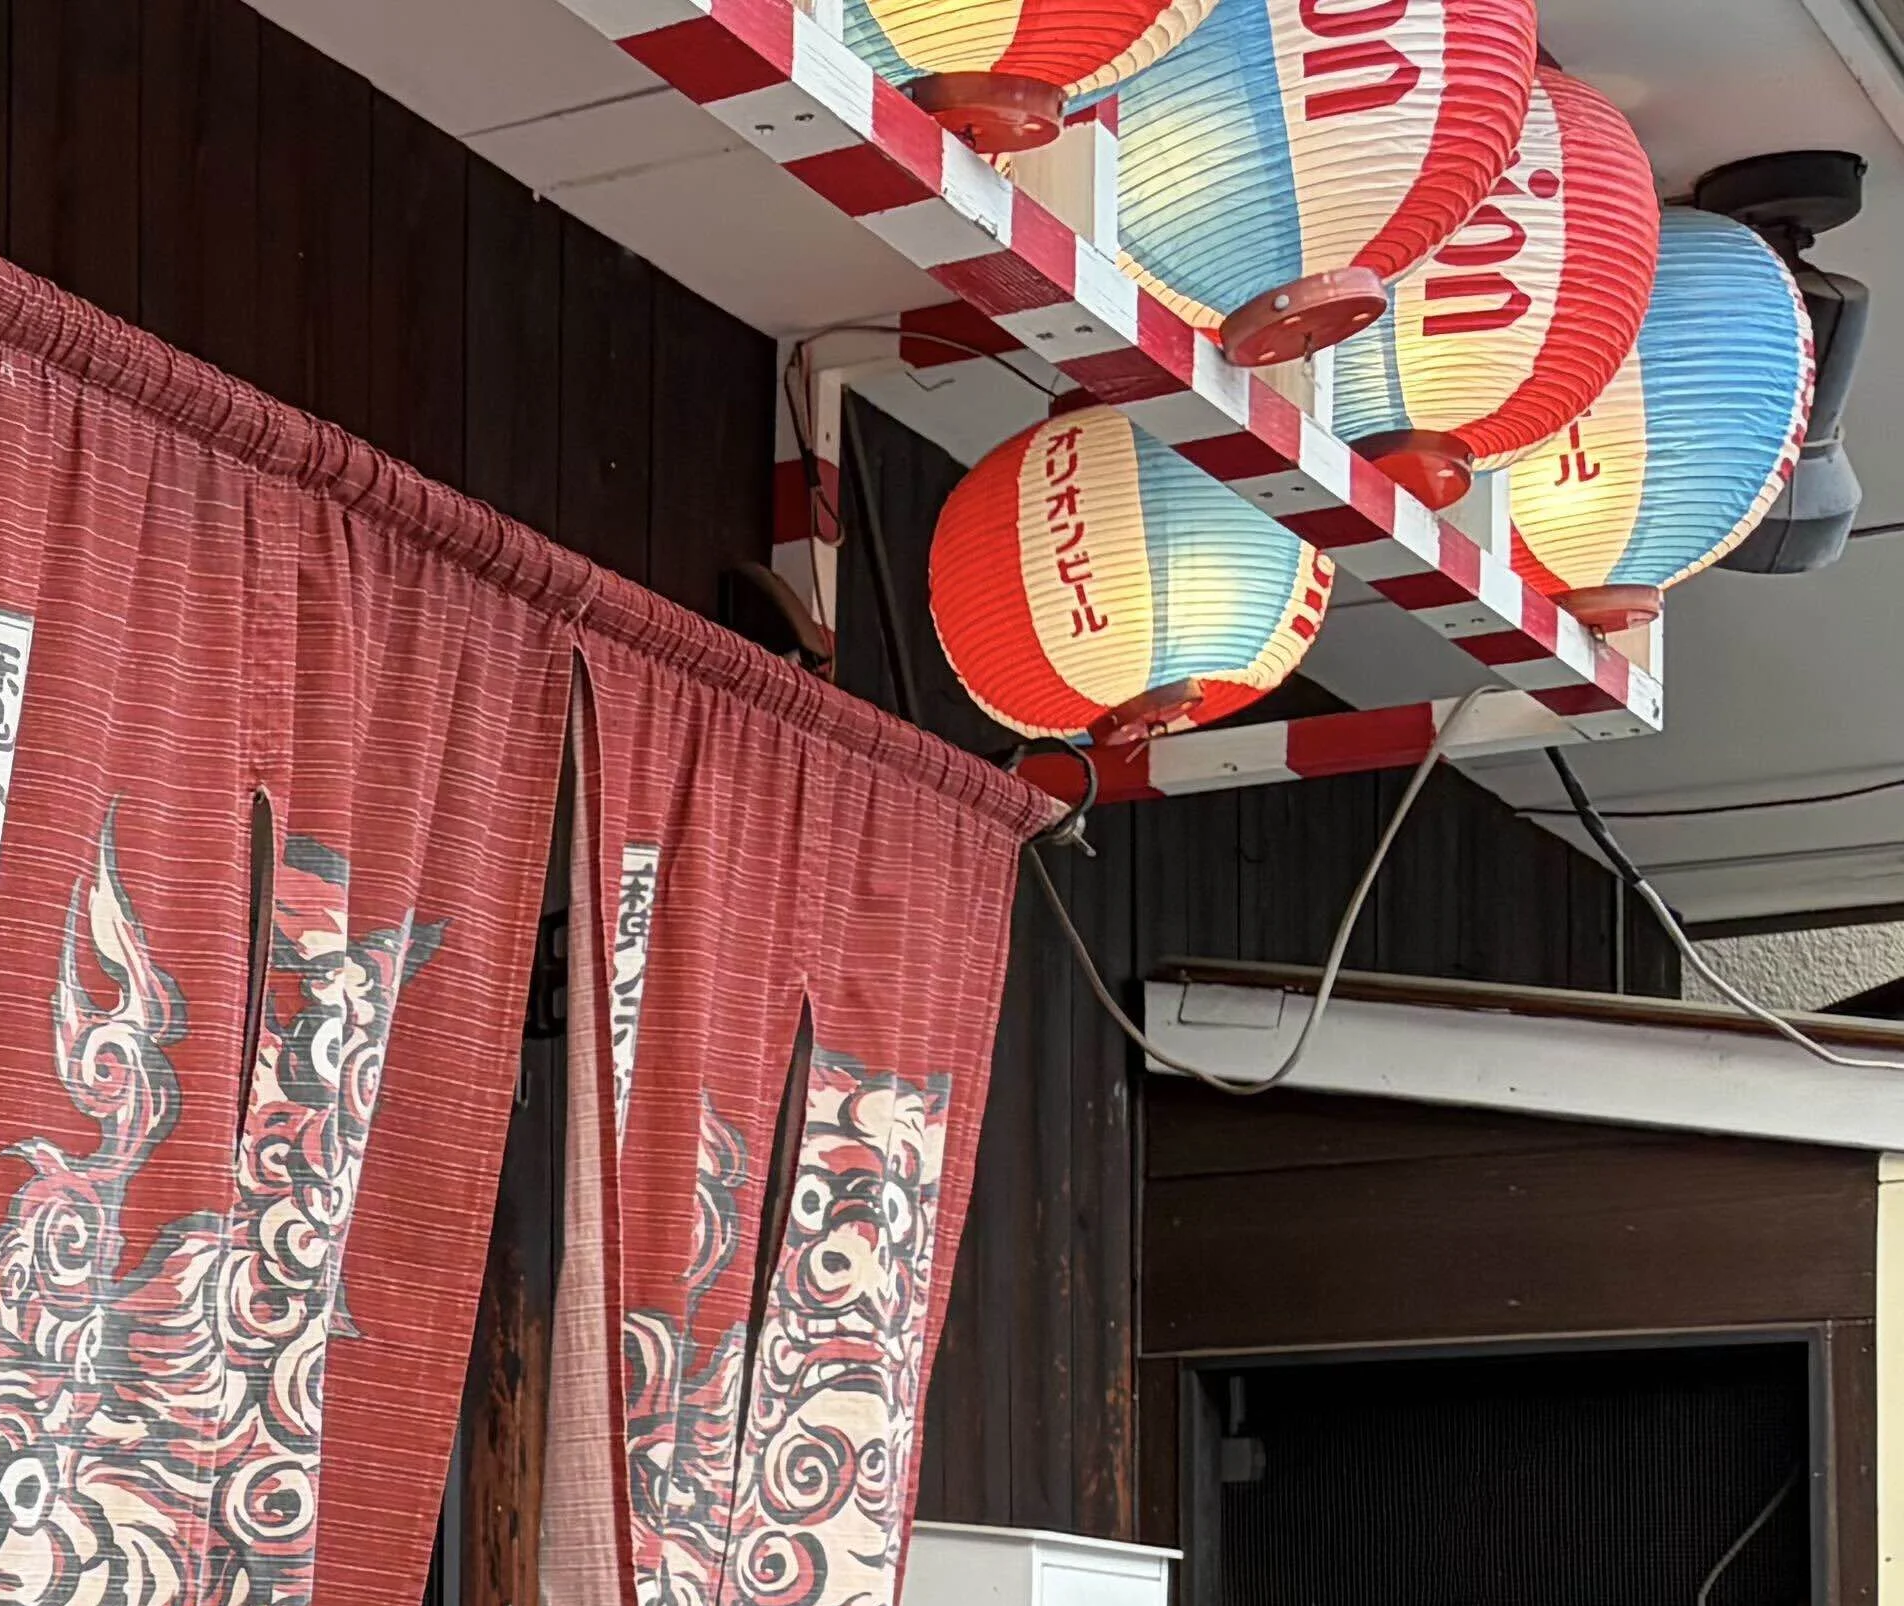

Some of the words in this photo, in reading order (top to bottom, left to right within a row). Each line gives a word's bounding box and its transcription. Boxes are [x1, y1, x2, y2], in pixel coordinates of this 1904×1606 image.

[1045, 427, 1109, 638] オリオンビール
